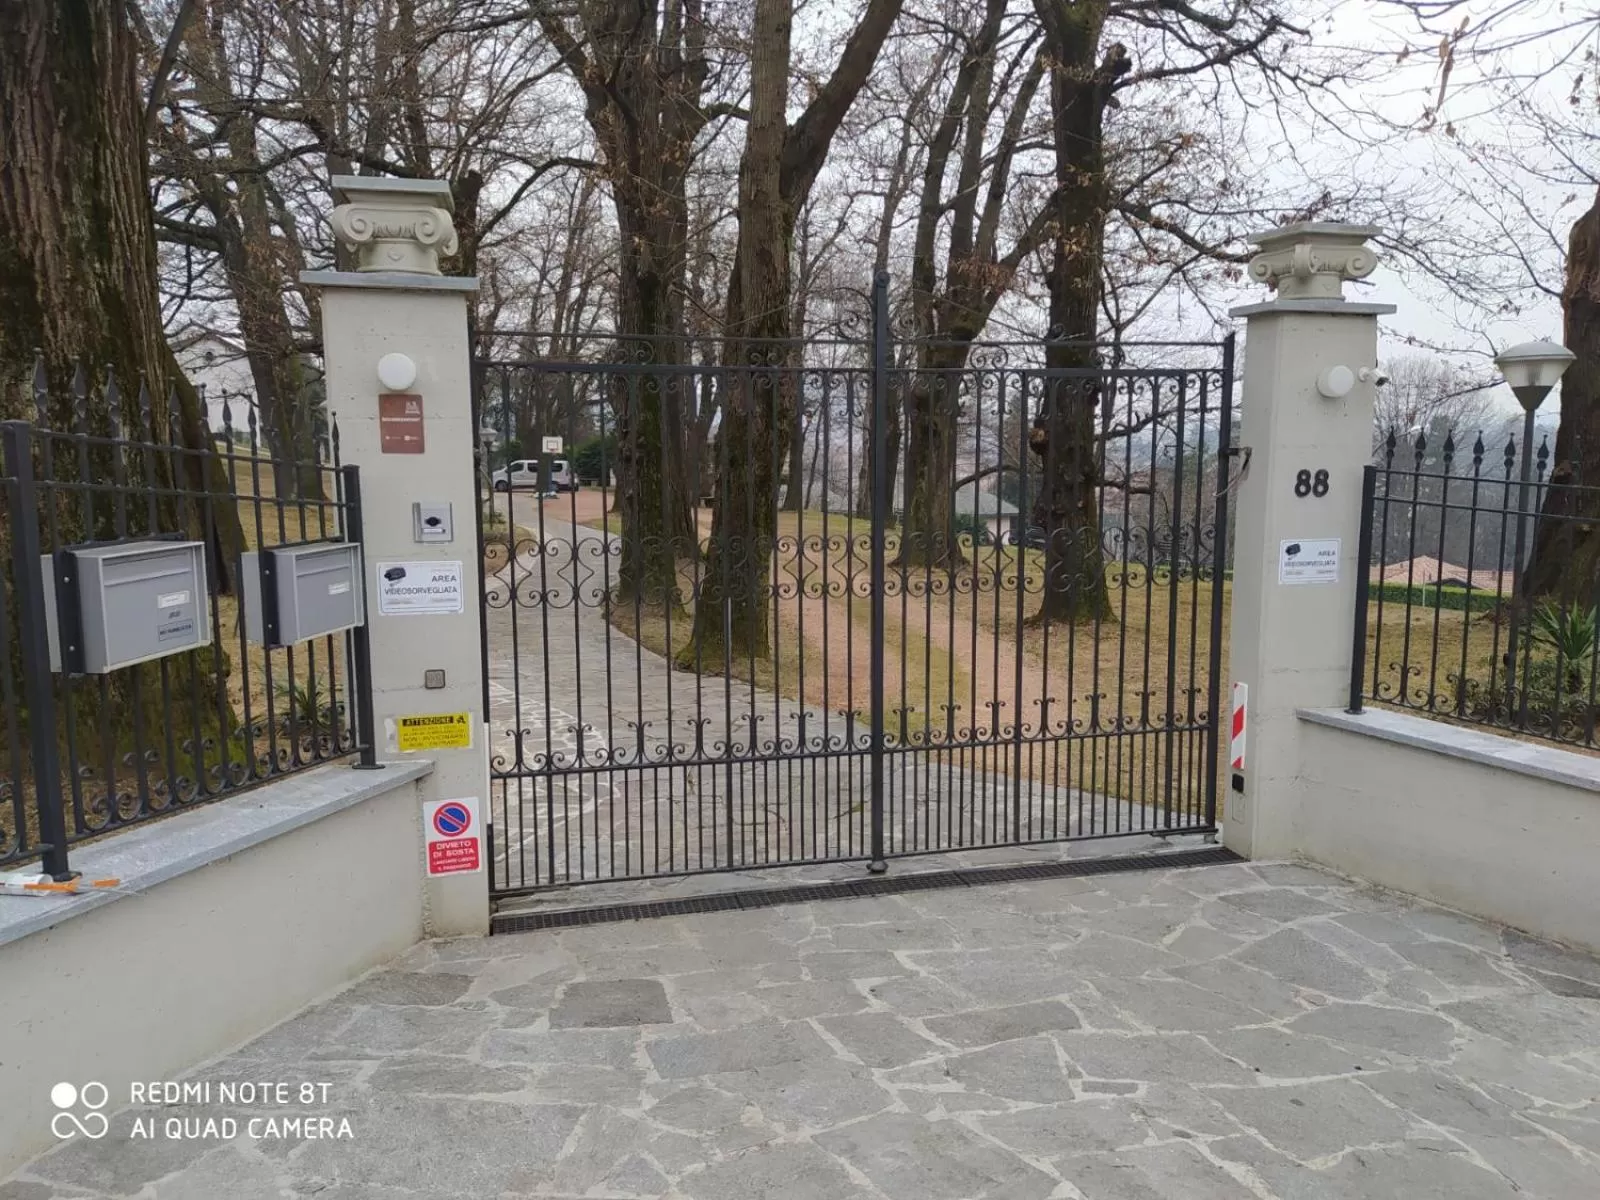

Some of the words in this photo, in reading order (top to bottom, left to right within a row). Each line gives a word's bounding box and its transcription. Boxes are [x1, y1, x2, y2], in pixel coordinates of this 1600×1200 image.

[1294, 469, 1330, 498] 88
[384, 586, 458, 595] VIDEOSORVEGLIATA
[436, 841, 472, 851] DIVIETO
[446, 849, 475, 858] SOSTA
